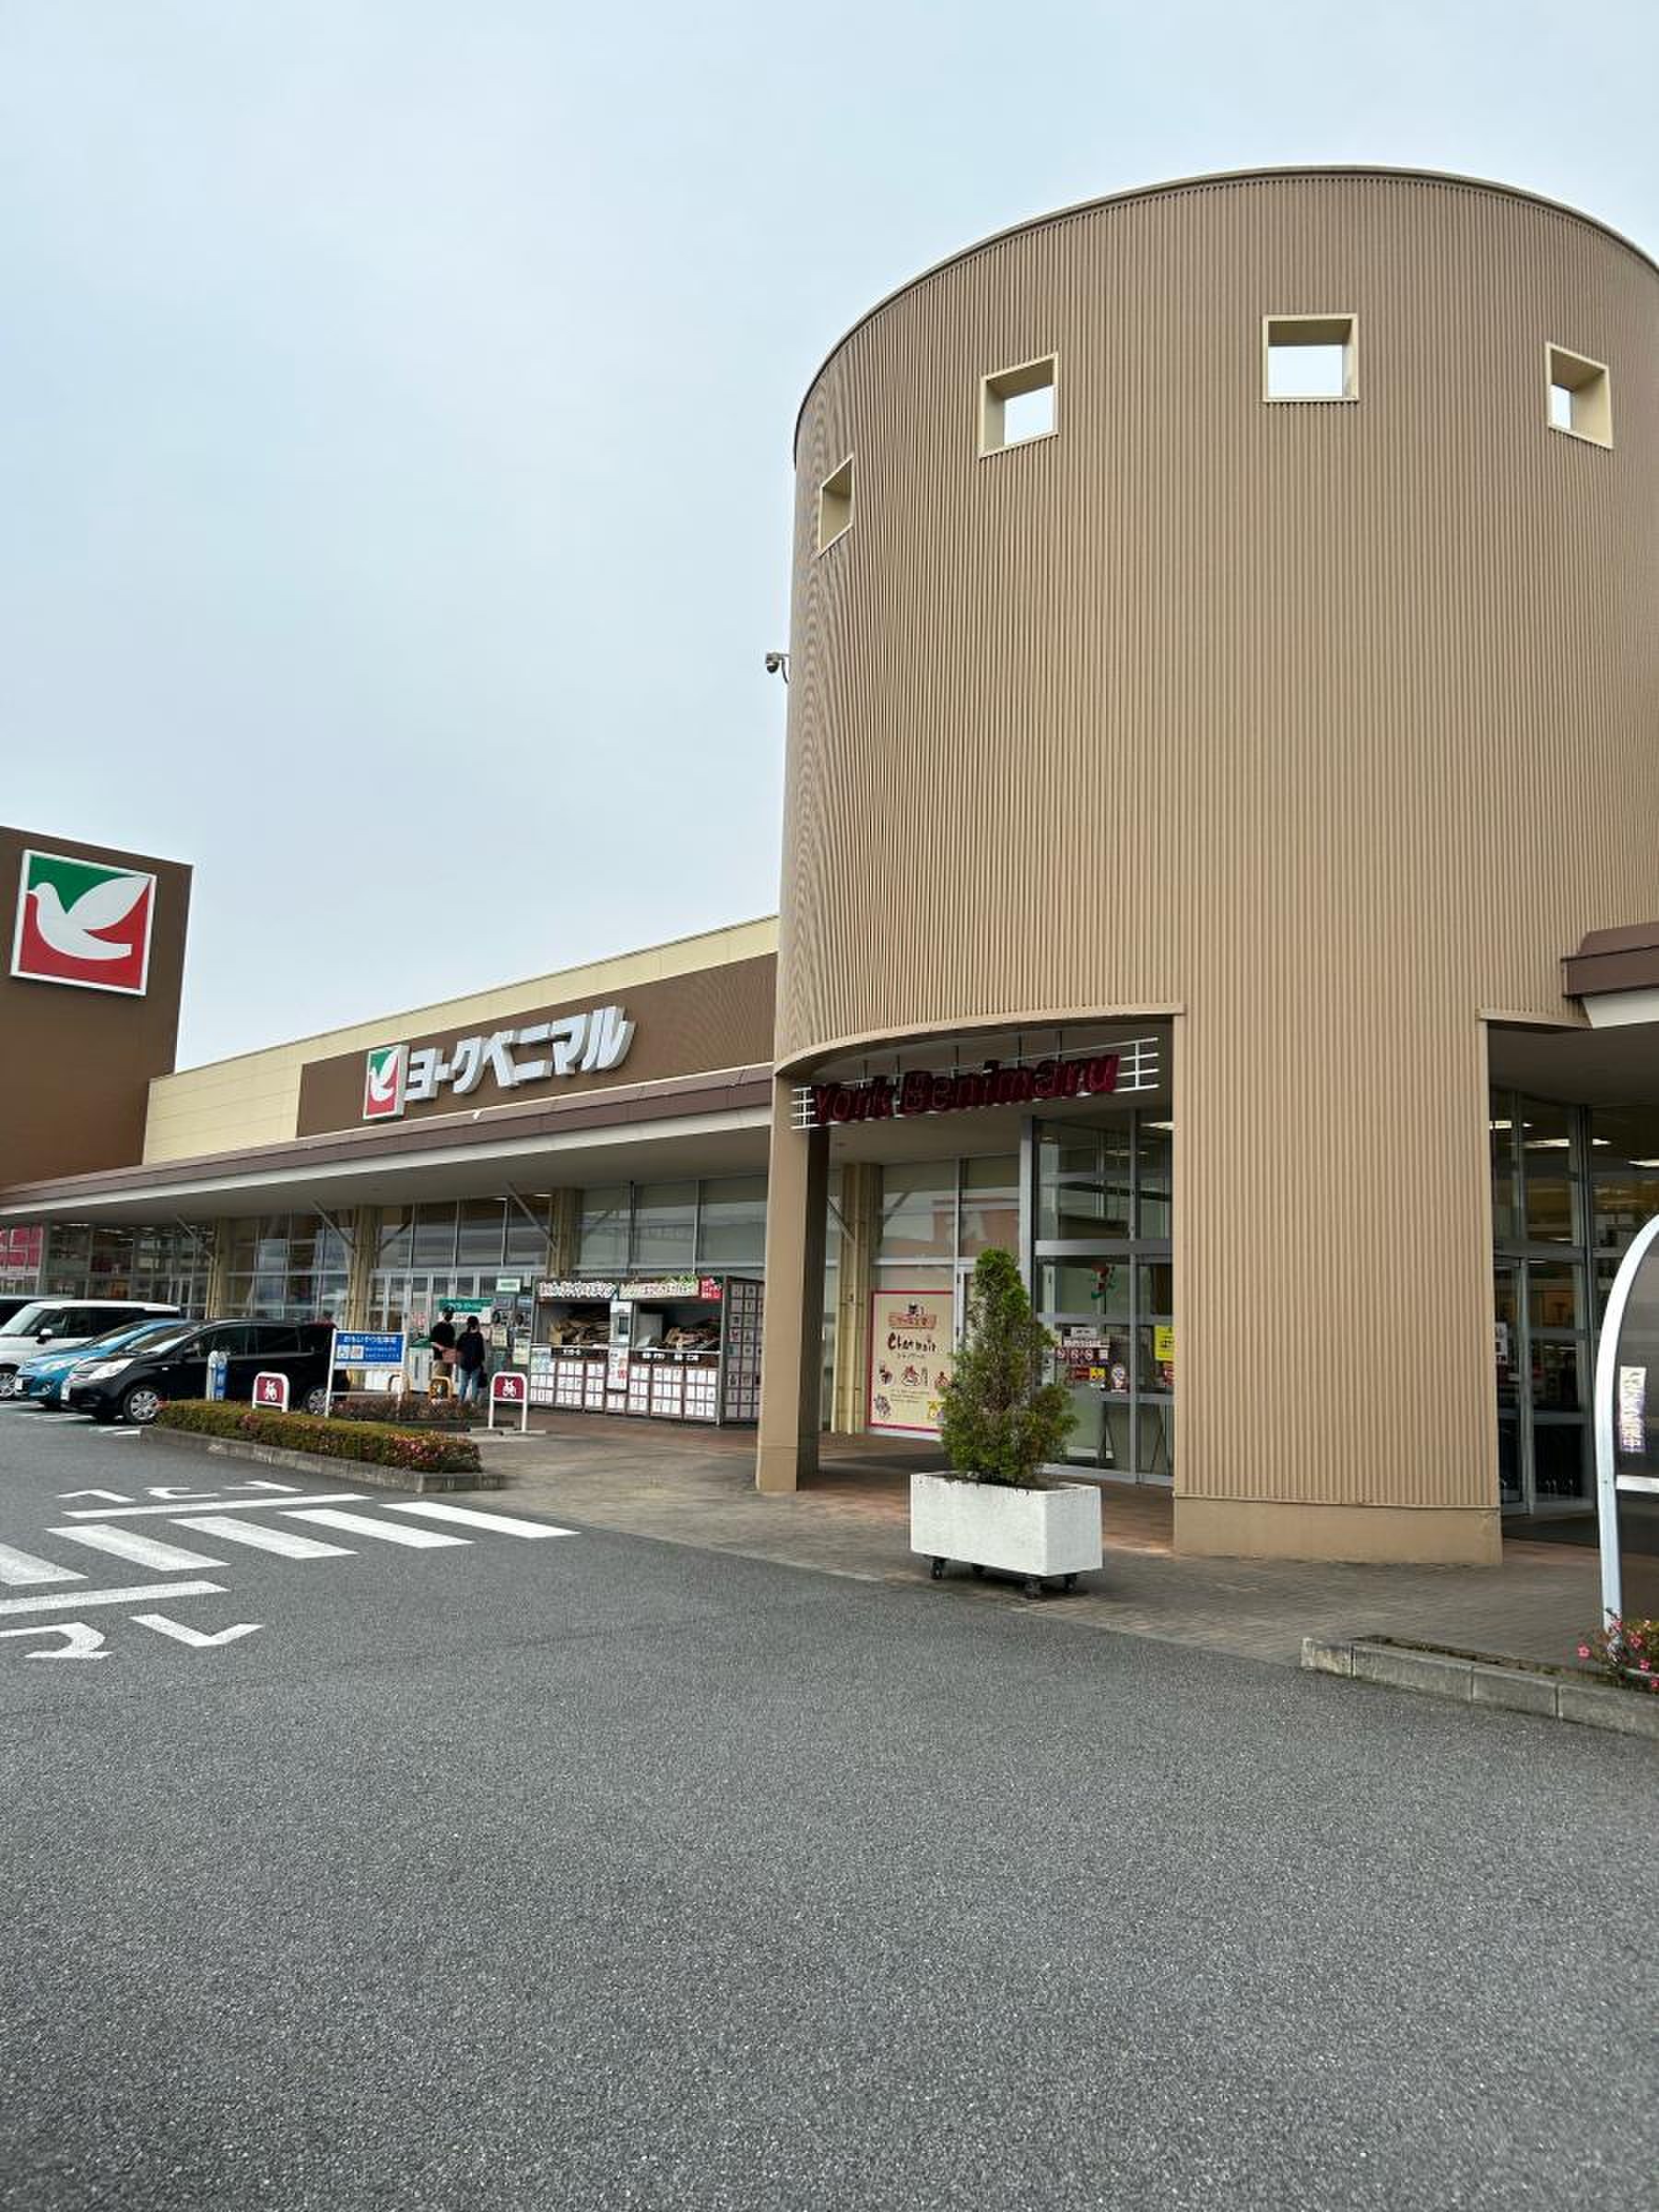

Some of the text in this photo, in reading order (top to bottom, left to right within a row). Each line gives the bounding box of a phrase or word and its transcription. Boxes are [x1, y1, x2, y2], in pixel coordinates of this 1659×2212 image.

[404, 1005, 636, 1102] ヨークベニマル
[810, 1053, 1121, 1124] York Benimaru
